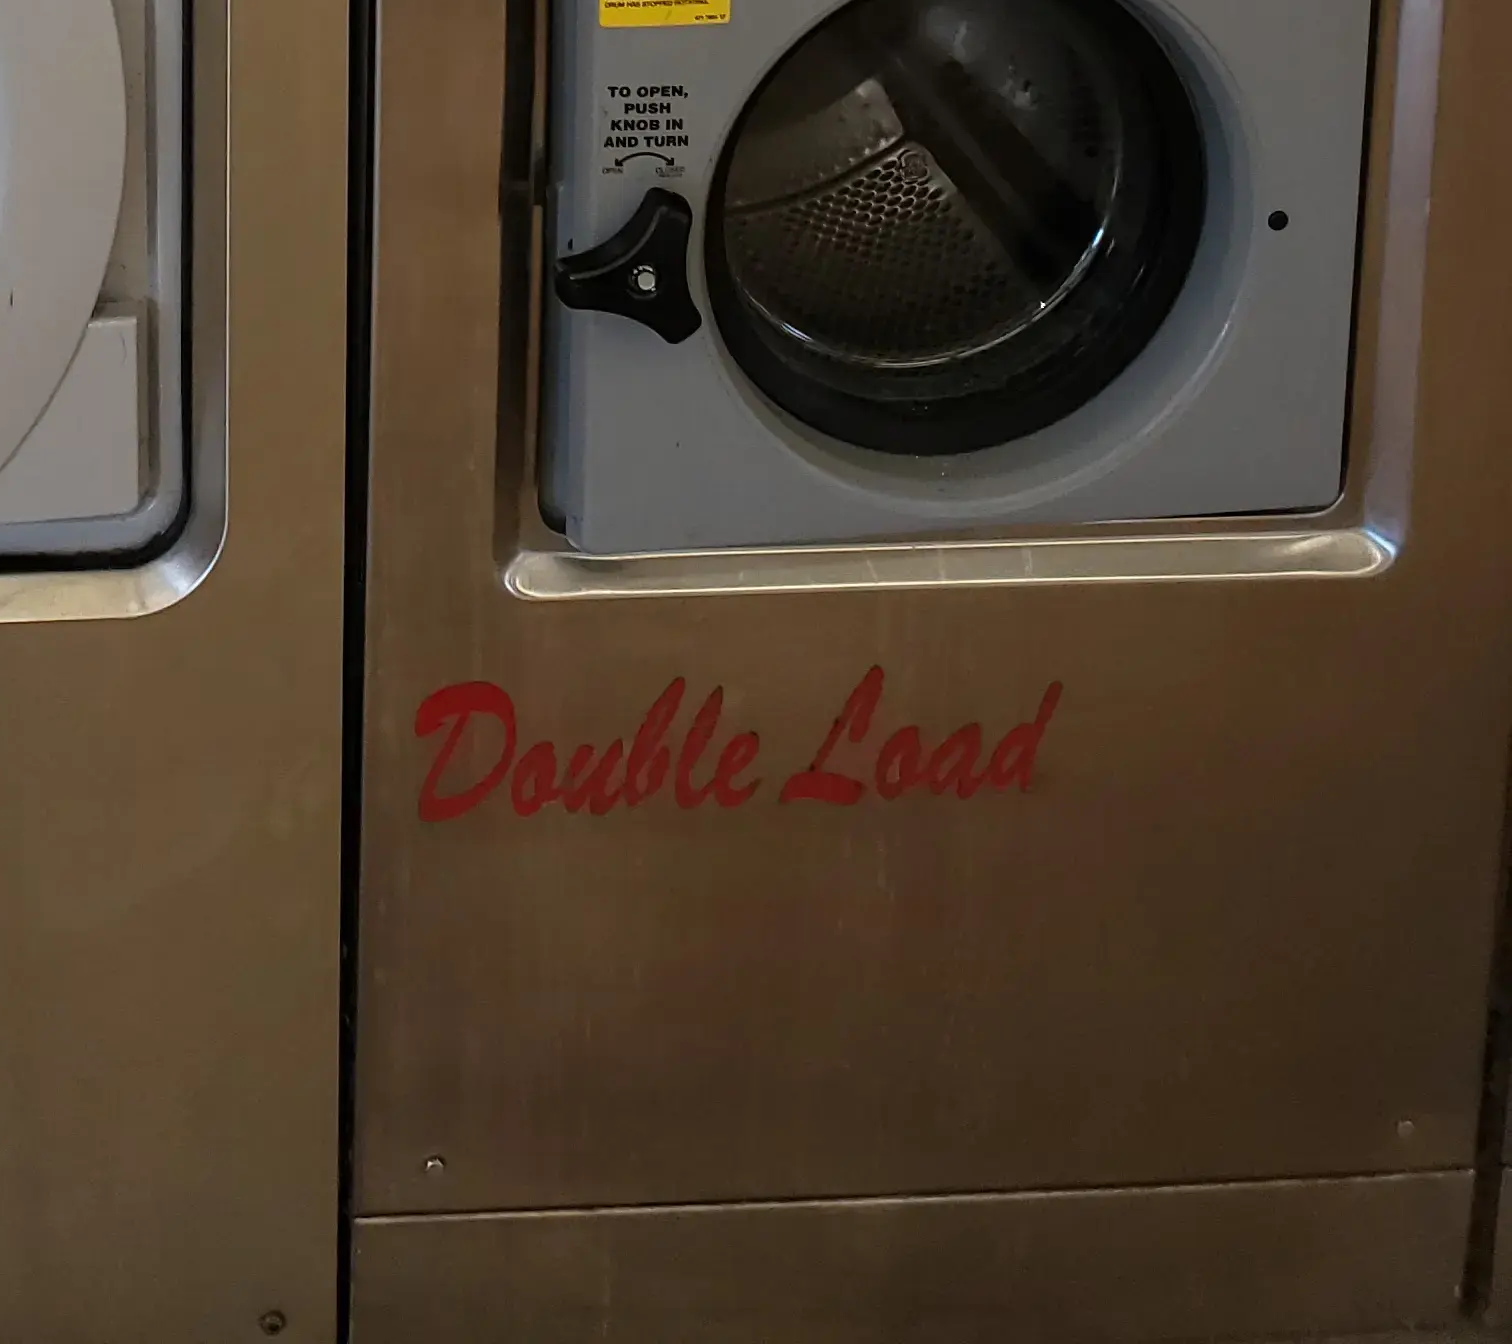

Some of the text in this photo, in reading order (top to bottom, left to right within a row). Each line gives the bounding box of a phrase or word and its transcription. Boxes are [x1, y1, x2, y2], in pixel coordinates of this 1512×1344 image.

[607, 85, 688, 99] TO OPEN,
[624, 102, 670, 114] PUSH
[610, 118, 683, 131] KNOB IN
[603, 135, 688, 147] AND TURN
[414, 664, 1064, 823] Double Load
